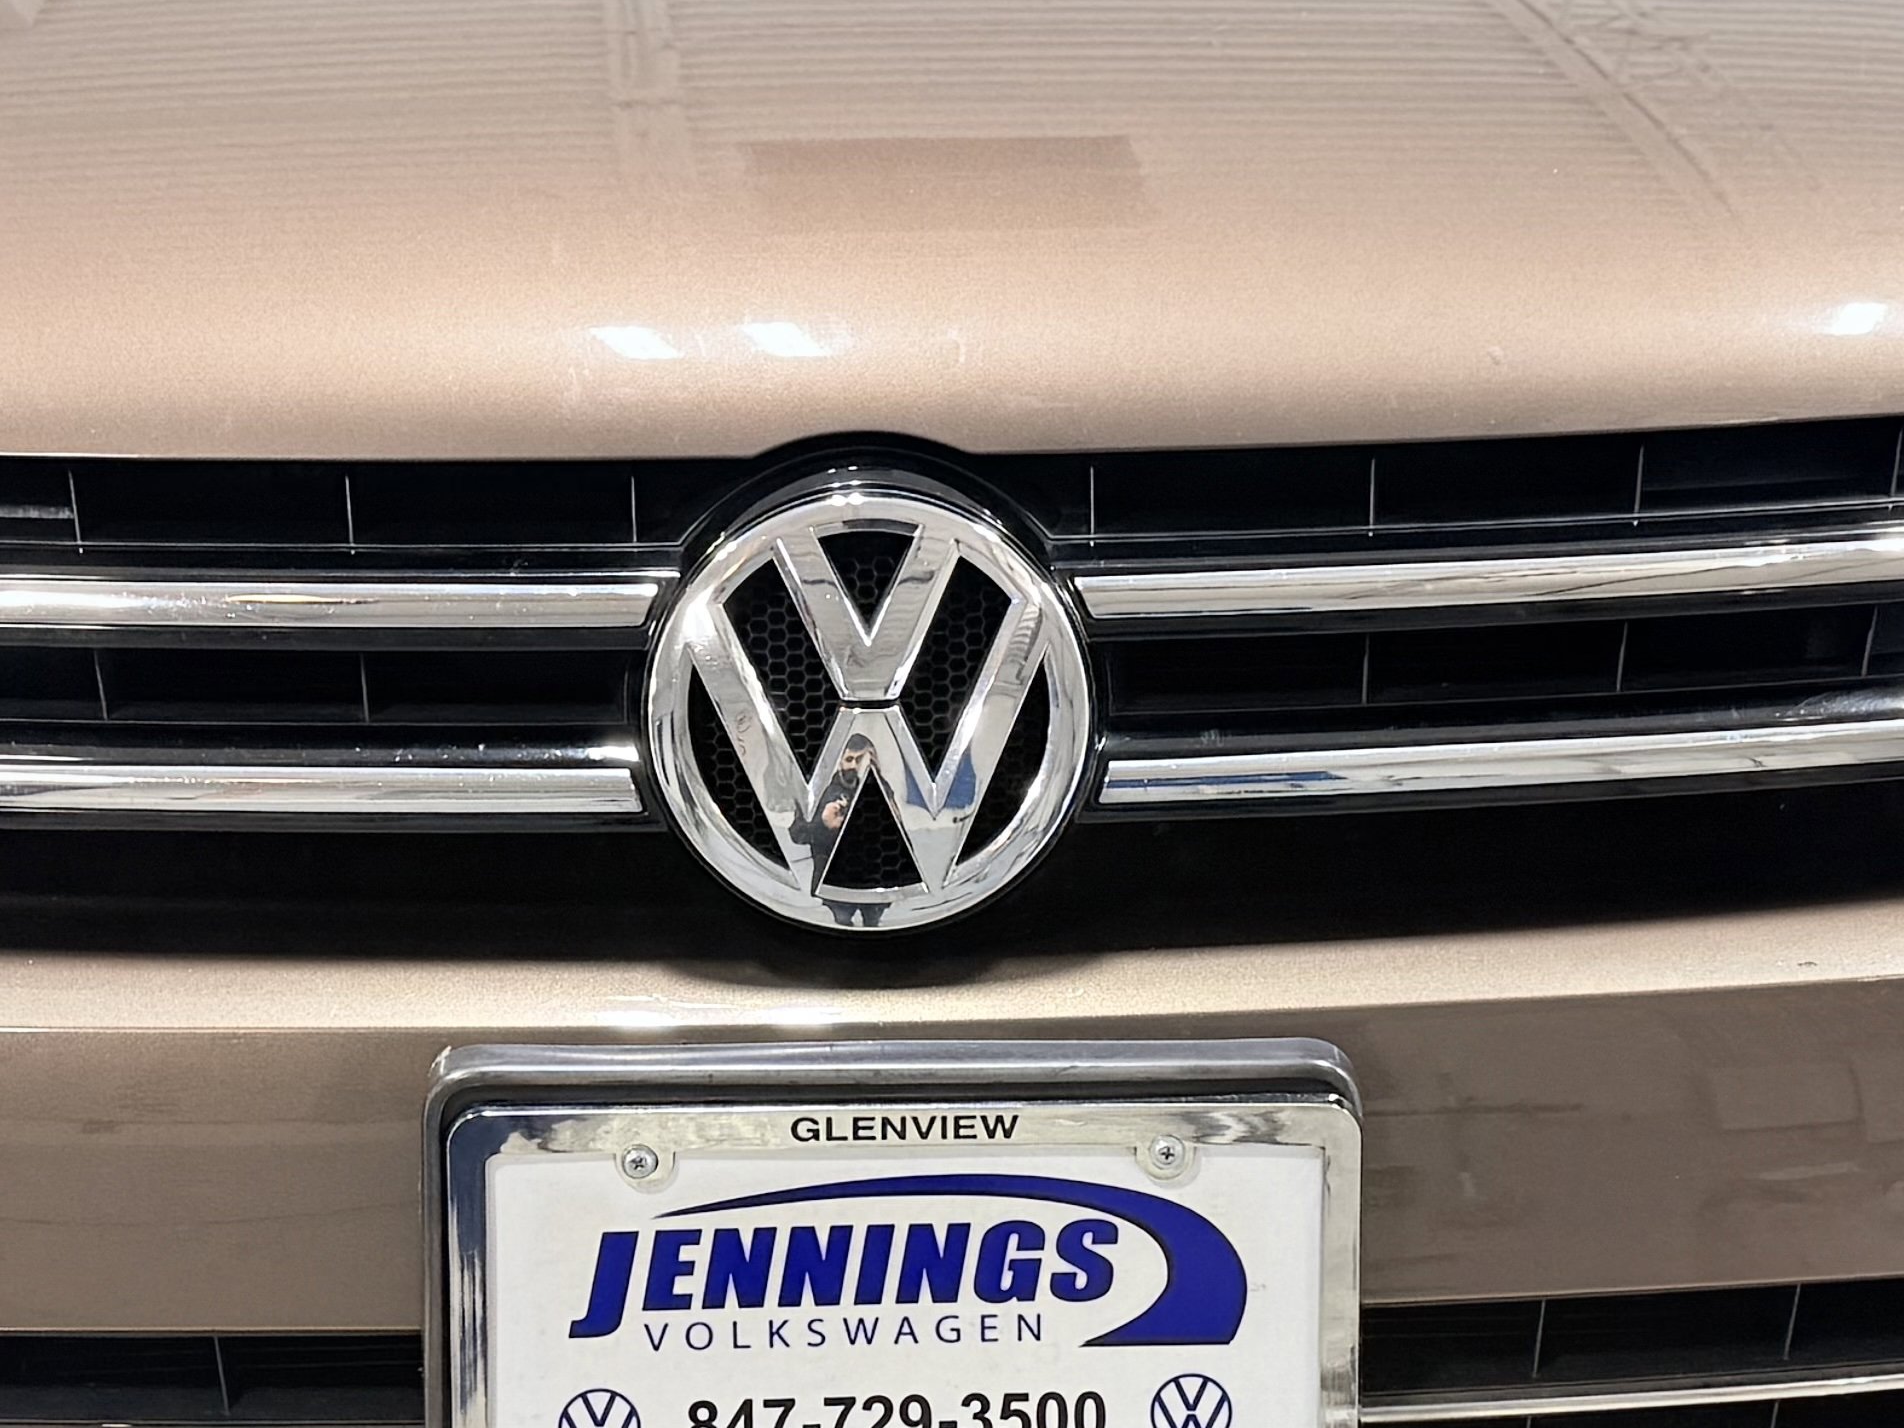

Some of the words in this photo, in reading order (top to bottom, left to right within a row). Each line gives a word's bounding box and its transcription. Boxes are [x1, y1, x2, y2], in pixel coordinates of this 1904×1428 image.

[790, 1113, 1020, 1143] GLENVIEW
[568, 1218, 1118, 1340] JENNINGS
[644, 1313, 1044, 1351] VOLKSWAGEN
